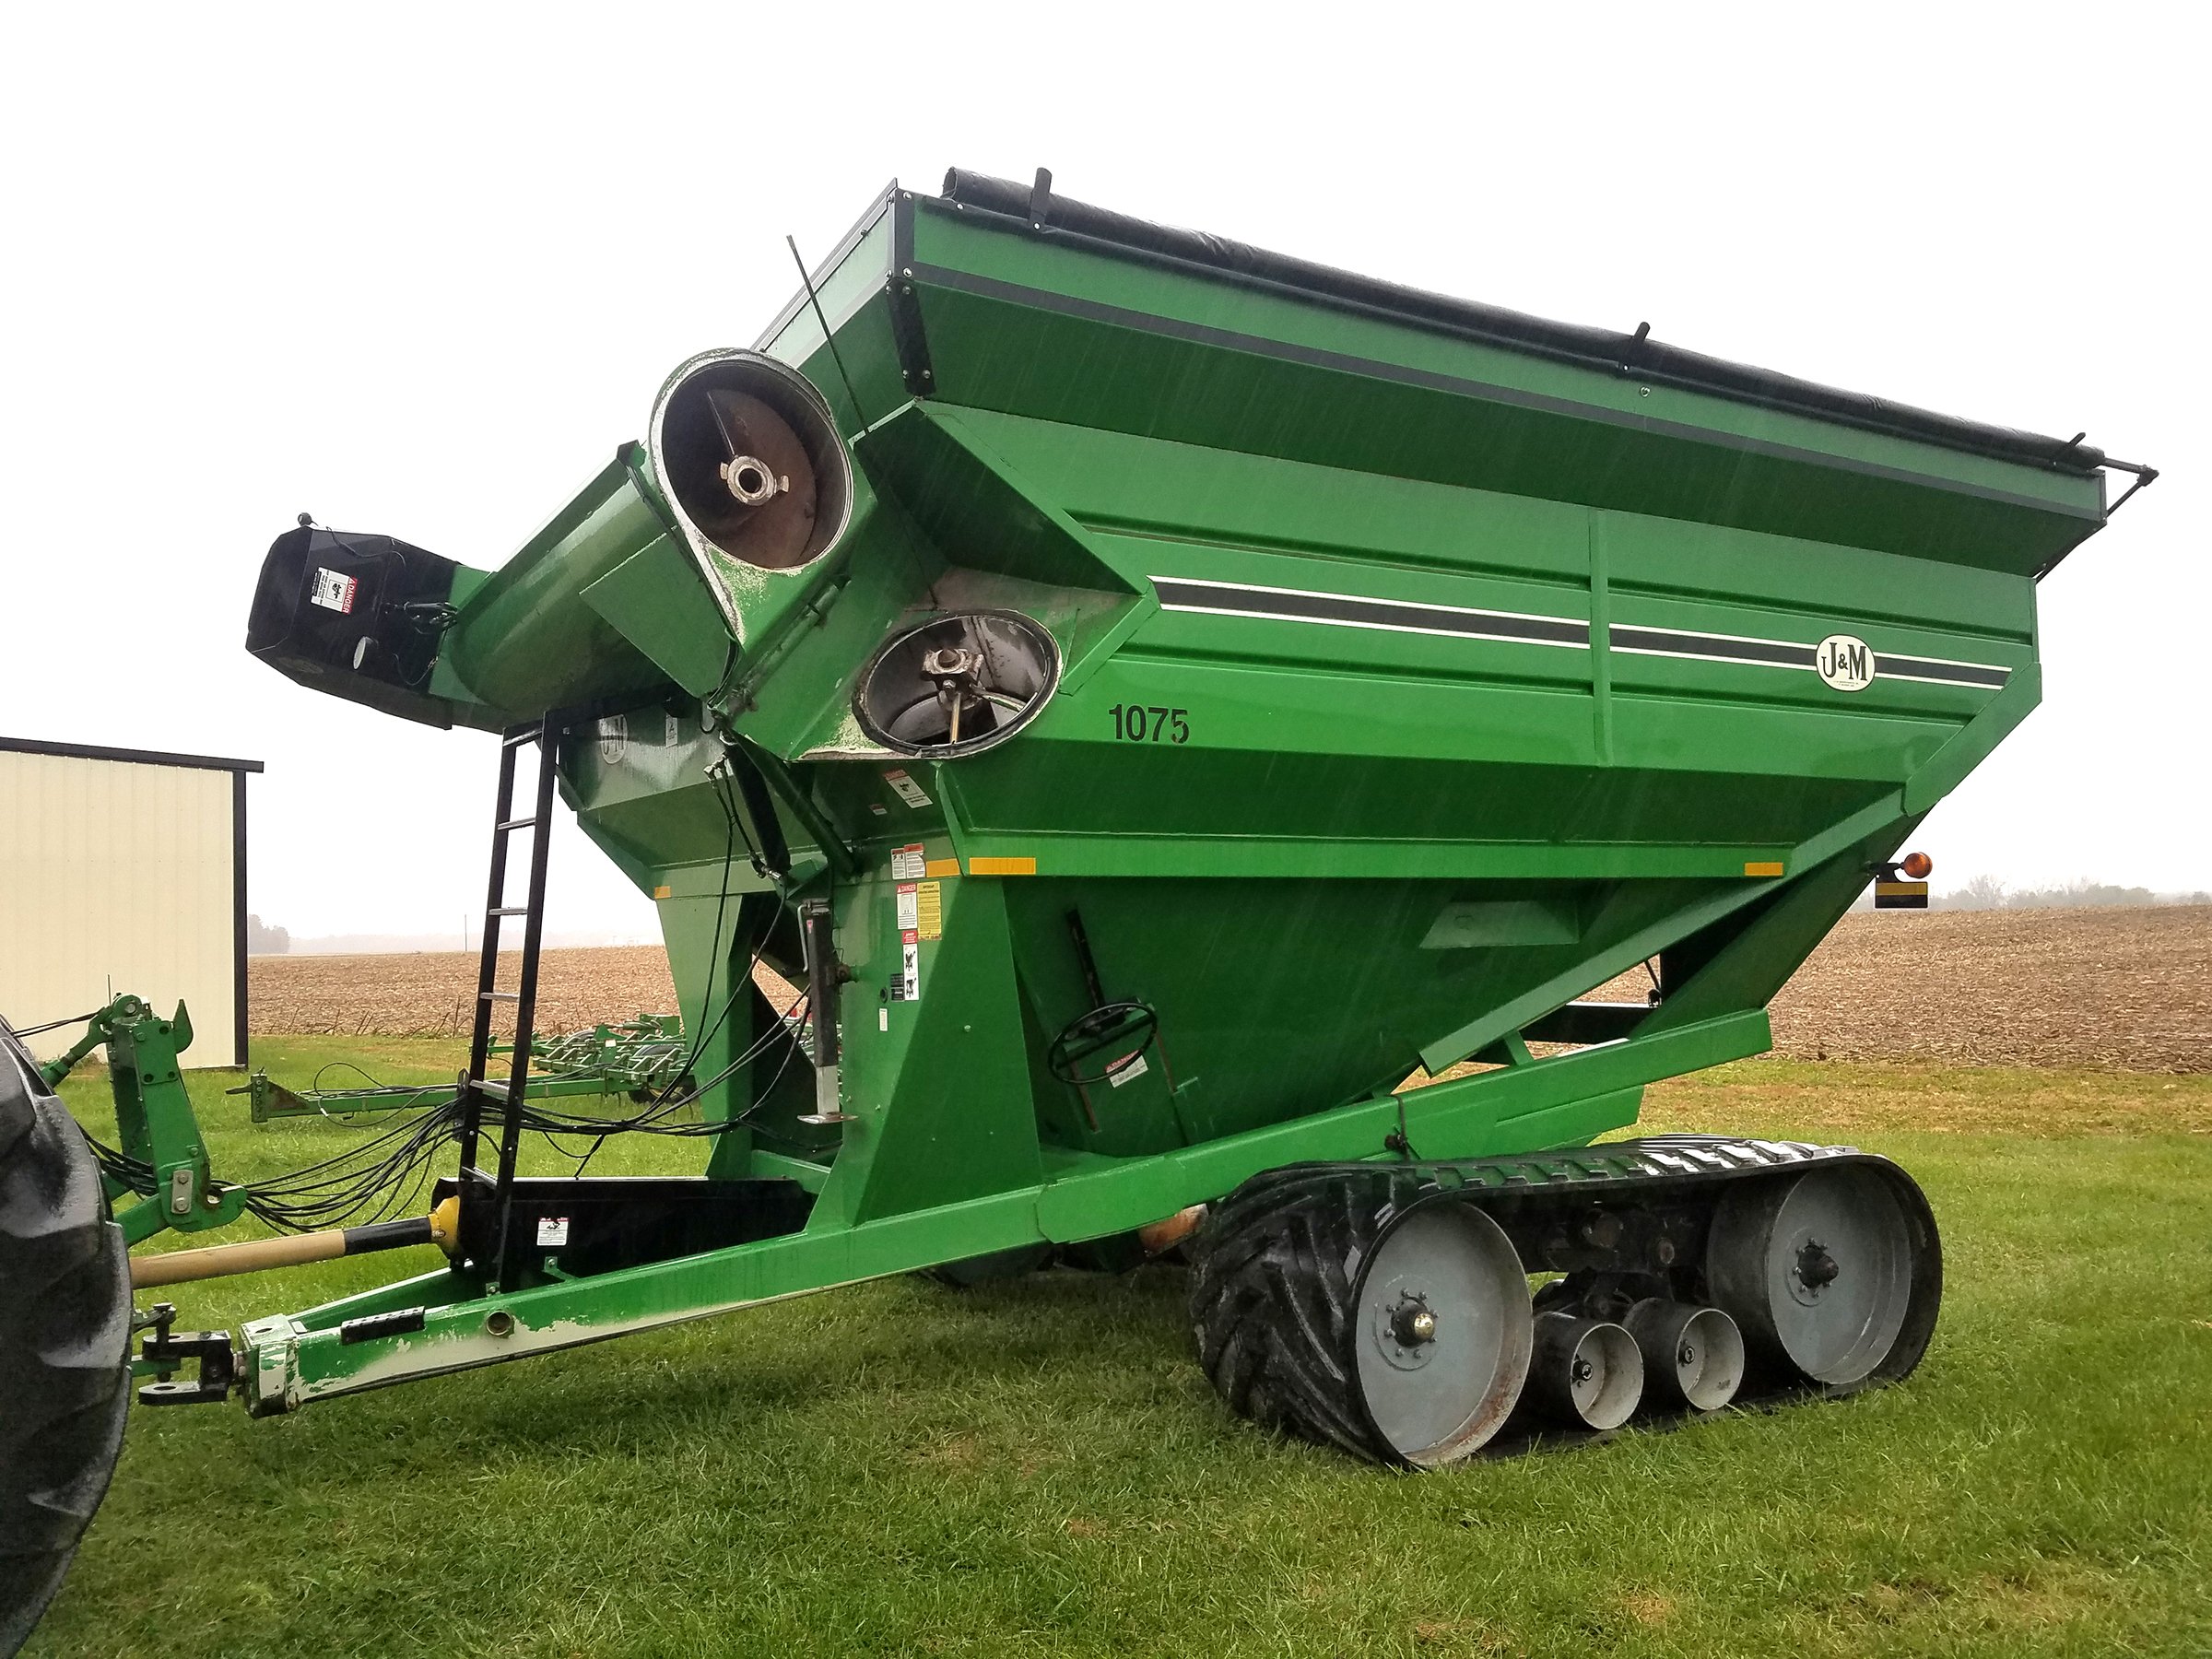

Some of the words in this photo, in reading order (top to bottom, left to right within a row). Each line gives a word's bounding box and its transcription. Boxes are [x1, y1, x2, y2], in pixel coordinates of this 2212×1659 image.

[342, 584, 355, 613] DANGER
[1821, 641, 1867, 681] J&M
[1108, 703, 1190, 744] 1075
